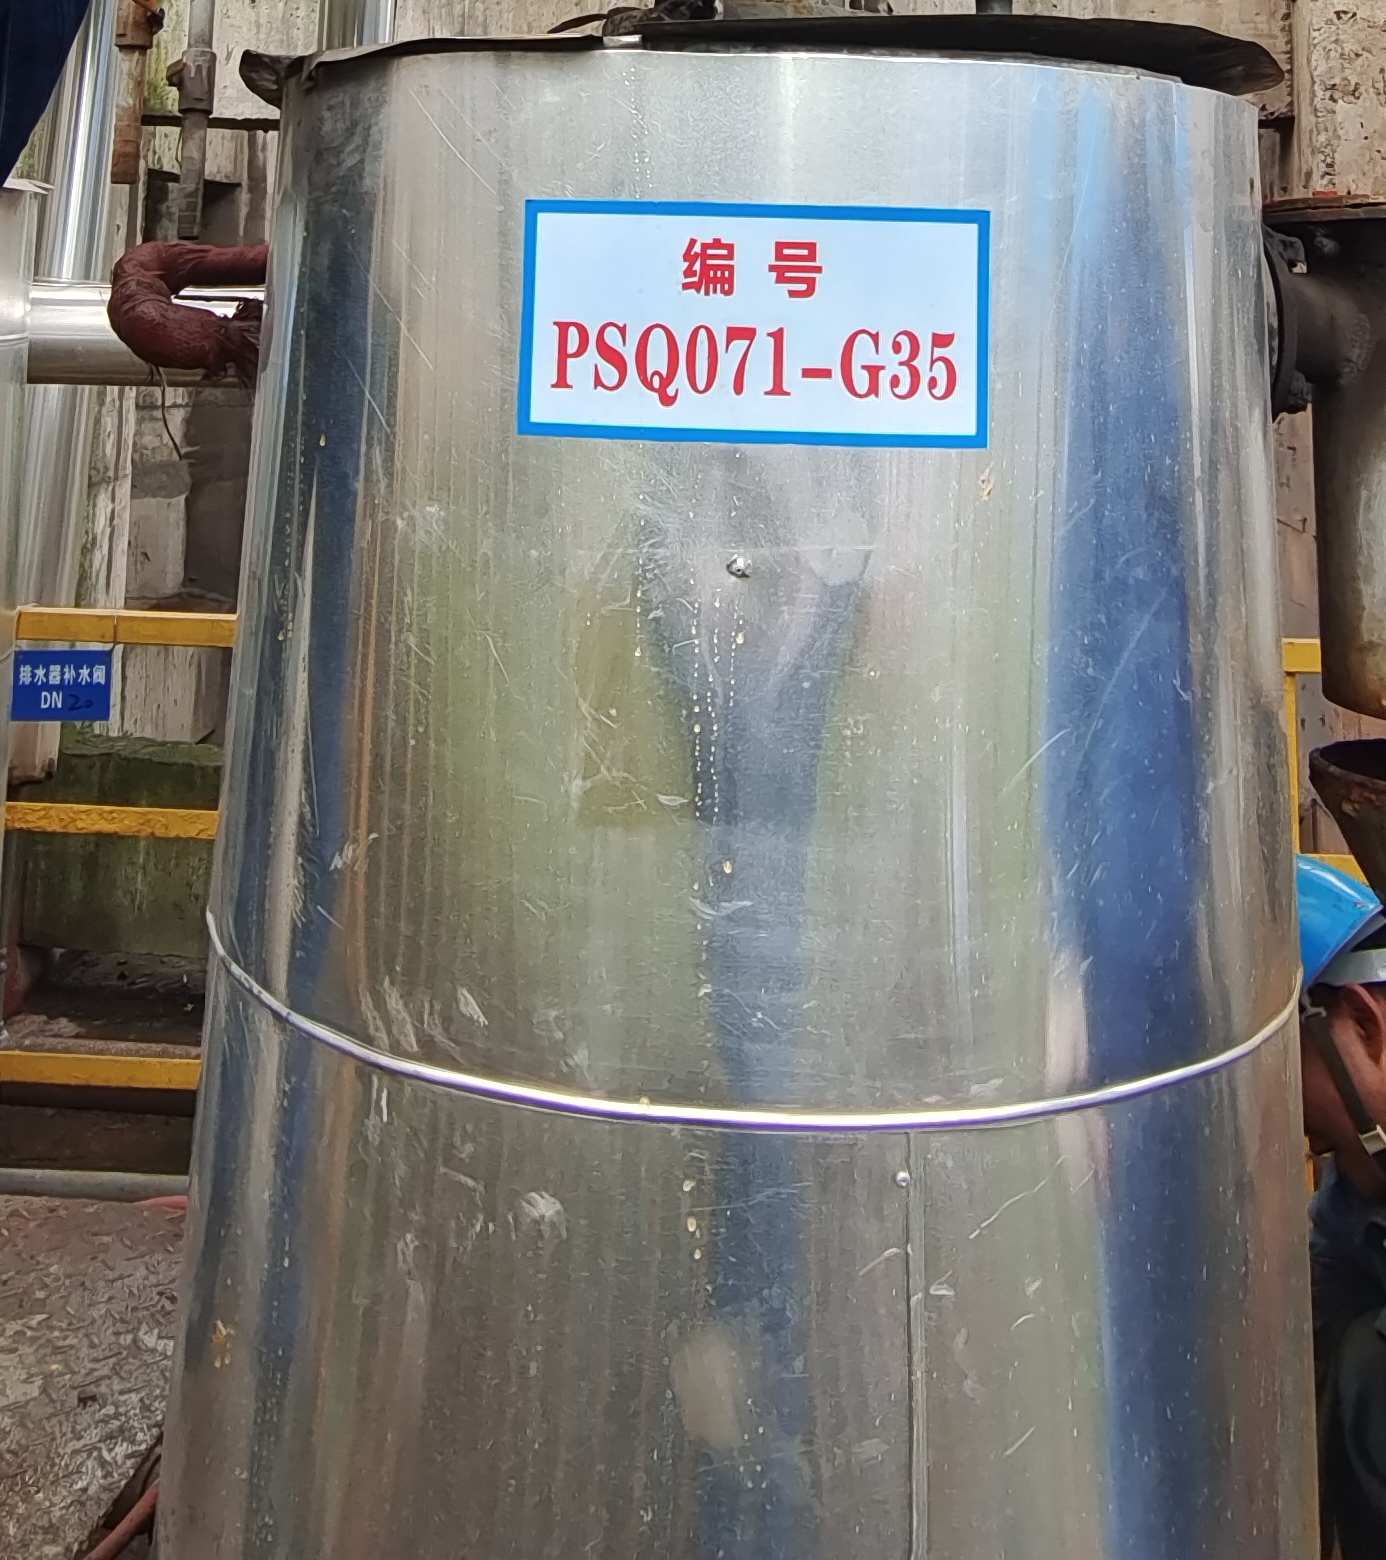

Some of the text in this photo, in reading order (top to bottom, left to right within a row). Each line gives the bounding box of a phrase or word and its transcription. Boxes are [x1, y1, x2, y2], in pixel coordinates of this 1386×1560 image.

[681, 237, 823, 299] 编号
[550, 321, 958, 407] PSQ071-G35
[19, 664, 106, 685] 排水器补水阀
[40, 691, 63, 709] DN
